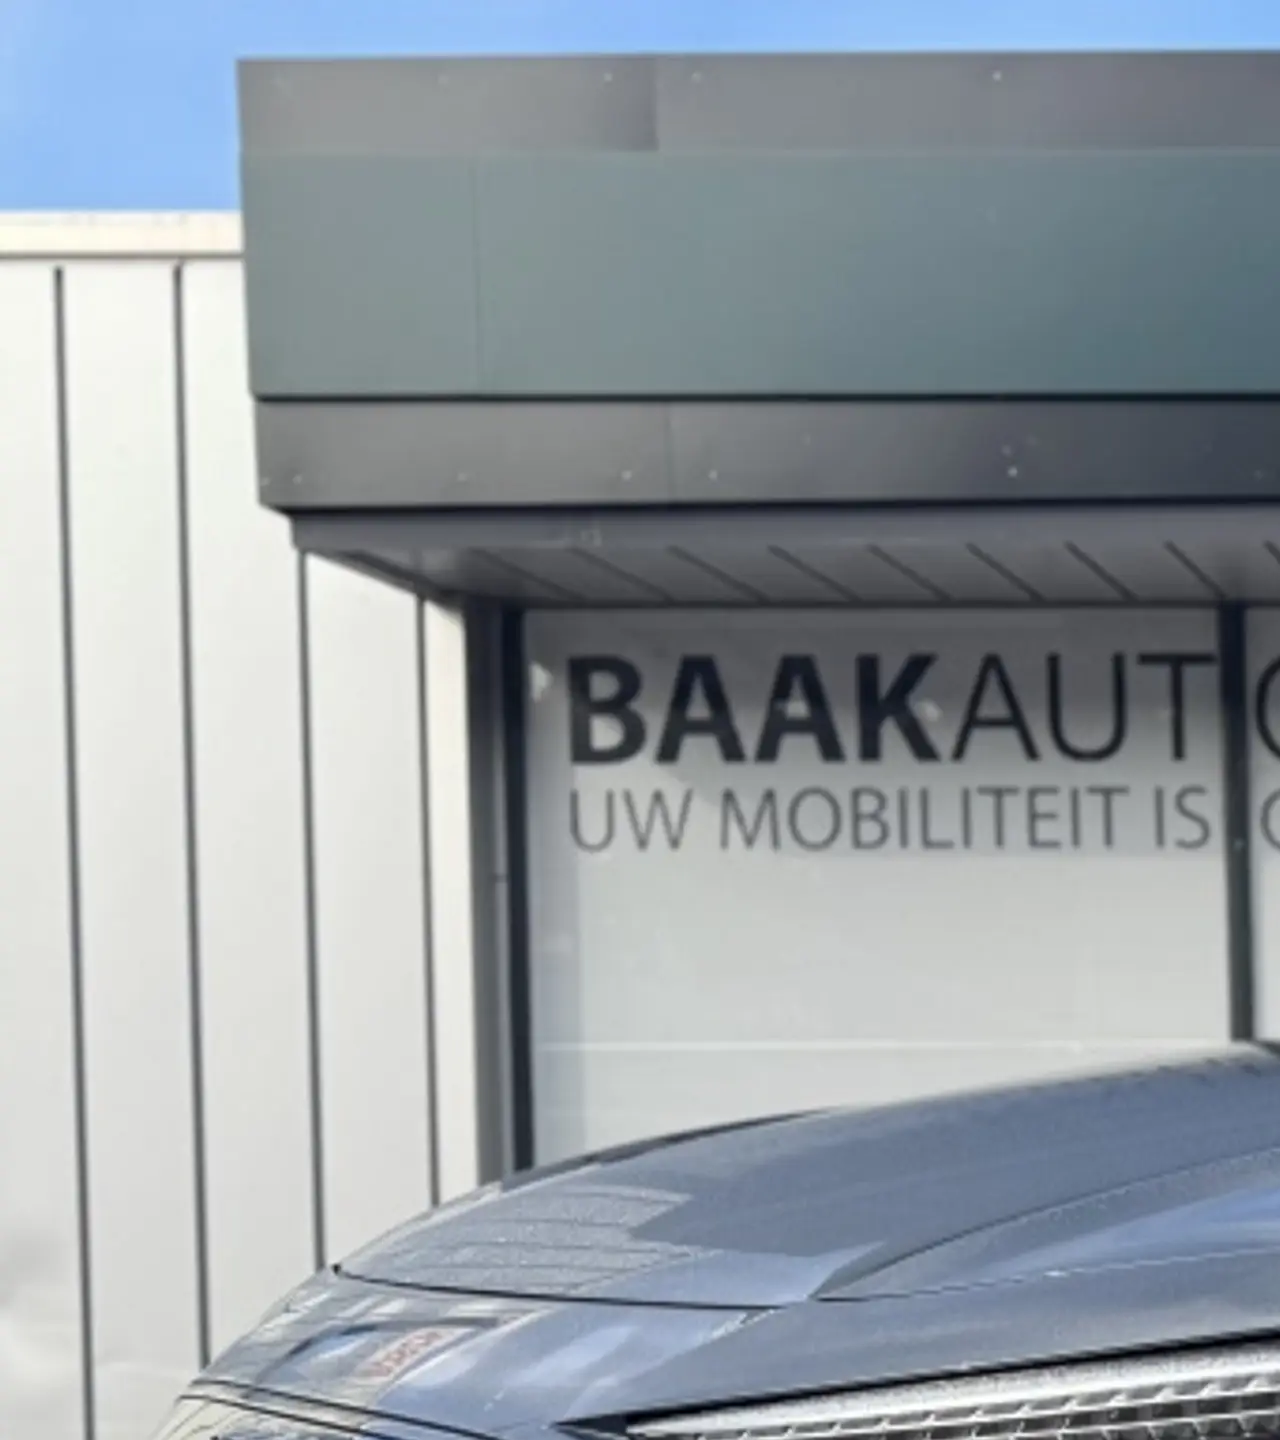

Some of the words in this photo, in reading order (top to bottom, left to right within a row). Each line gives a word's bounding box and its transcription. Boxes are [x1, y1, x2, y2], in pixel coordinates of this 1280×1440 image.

[569, 788, 693, 854] UW
[720, 786, 1130, 852] MOBILITEIT
[1154, 786, 1211, 850] IS
